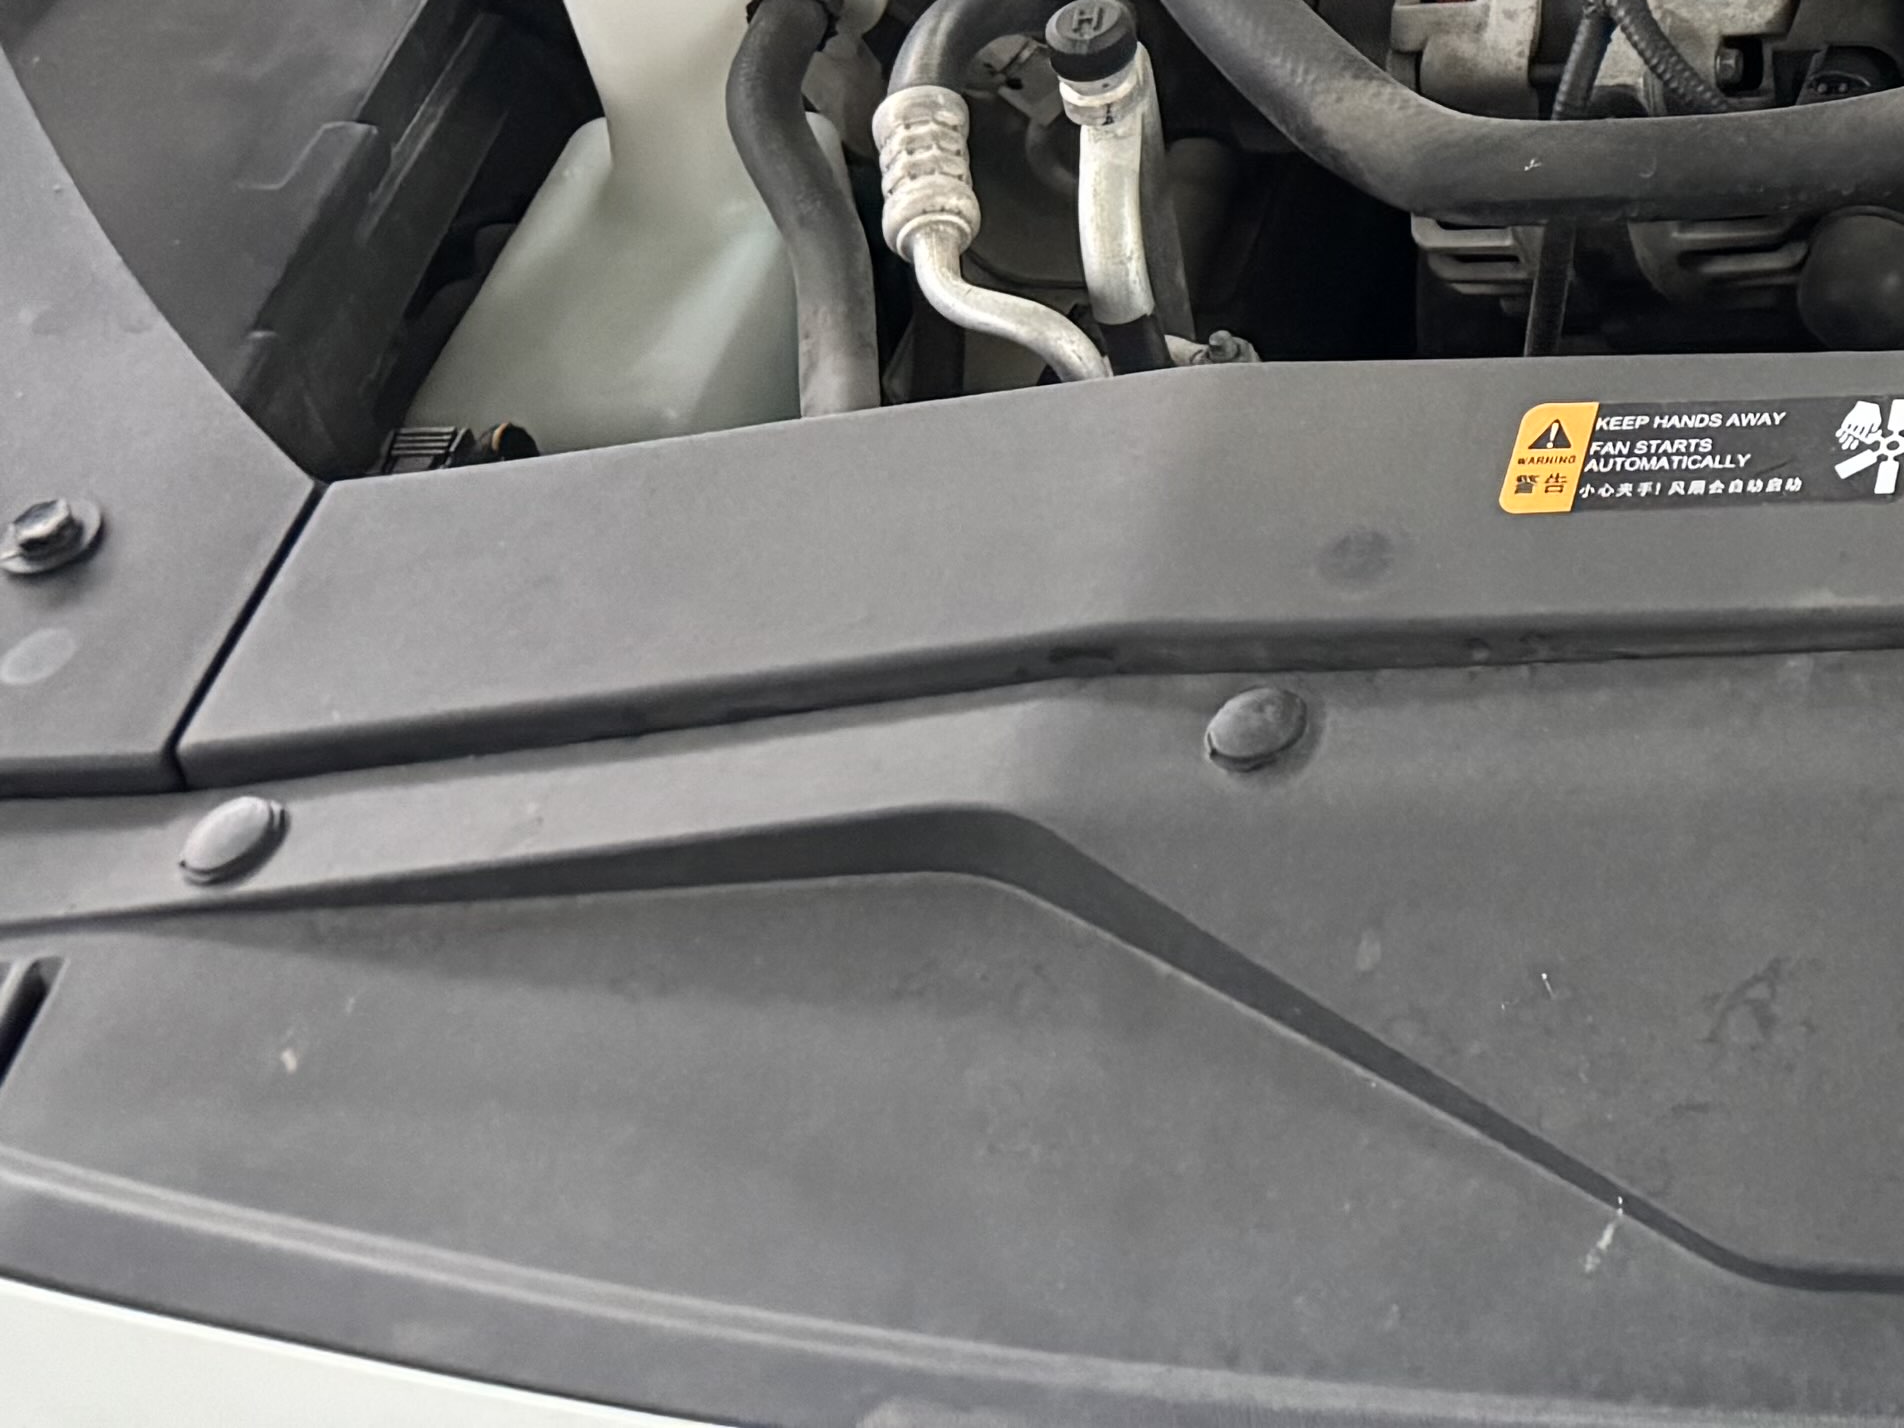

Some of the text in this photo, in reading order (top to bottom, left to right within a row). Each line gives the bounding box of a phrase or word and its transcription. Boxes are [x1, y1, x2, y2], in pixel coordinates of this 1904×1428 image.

[1072, 6, 1105, 32] H
[1595, 411, 1787, 431] KEEP HANDS AWAY
[1589, 438, 1713, 455] FAN STARTS
[1517, 454, 1577, 466] WARNING
[1584, 453, 1751, 472] AUTOMATICALLY
[1514, 472, 1569, 495] 警告
